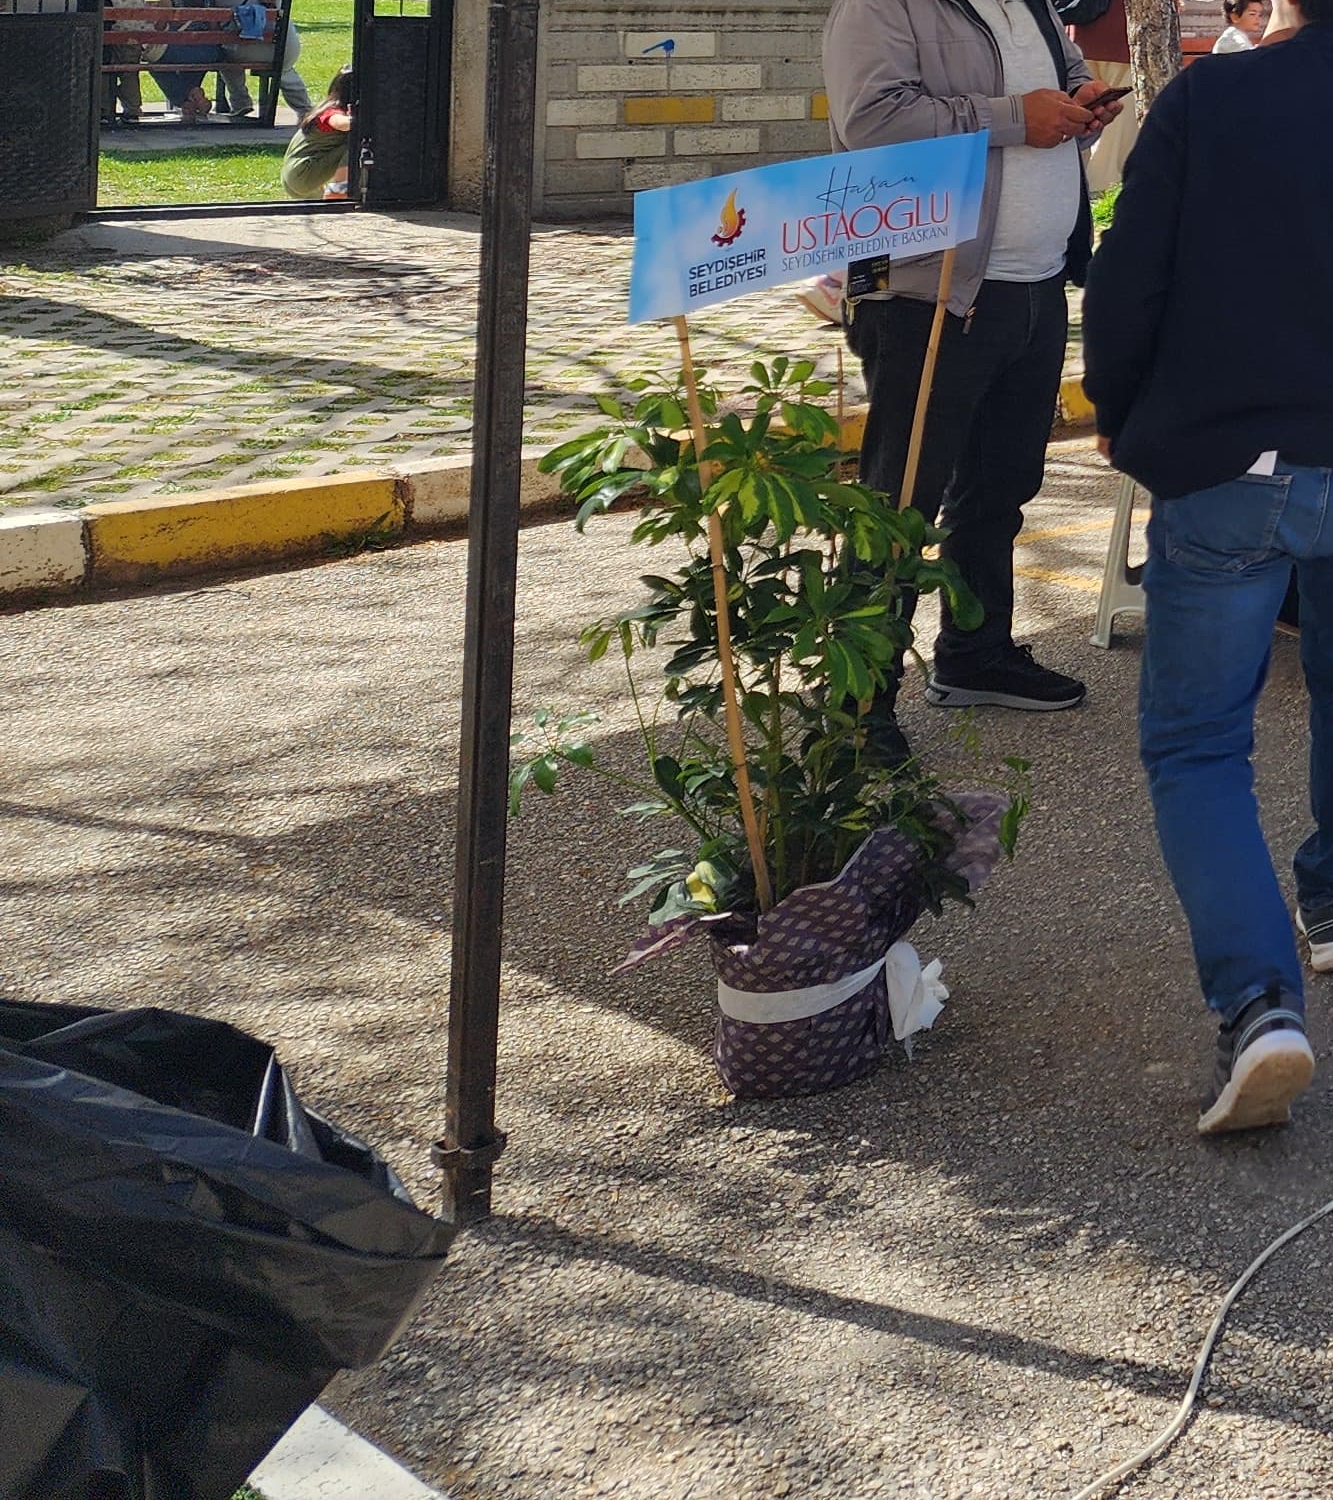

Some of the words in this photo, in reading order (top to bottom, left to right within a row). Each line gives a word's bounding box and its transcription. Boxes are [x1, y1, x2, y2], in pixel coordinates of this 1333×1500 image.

[783, 191, 950, 255] USTAOĞLU
[689, 248, 766, 280] SEYDİŞEHİR
[689, 264, 767, 298] BELEDİYESİ
